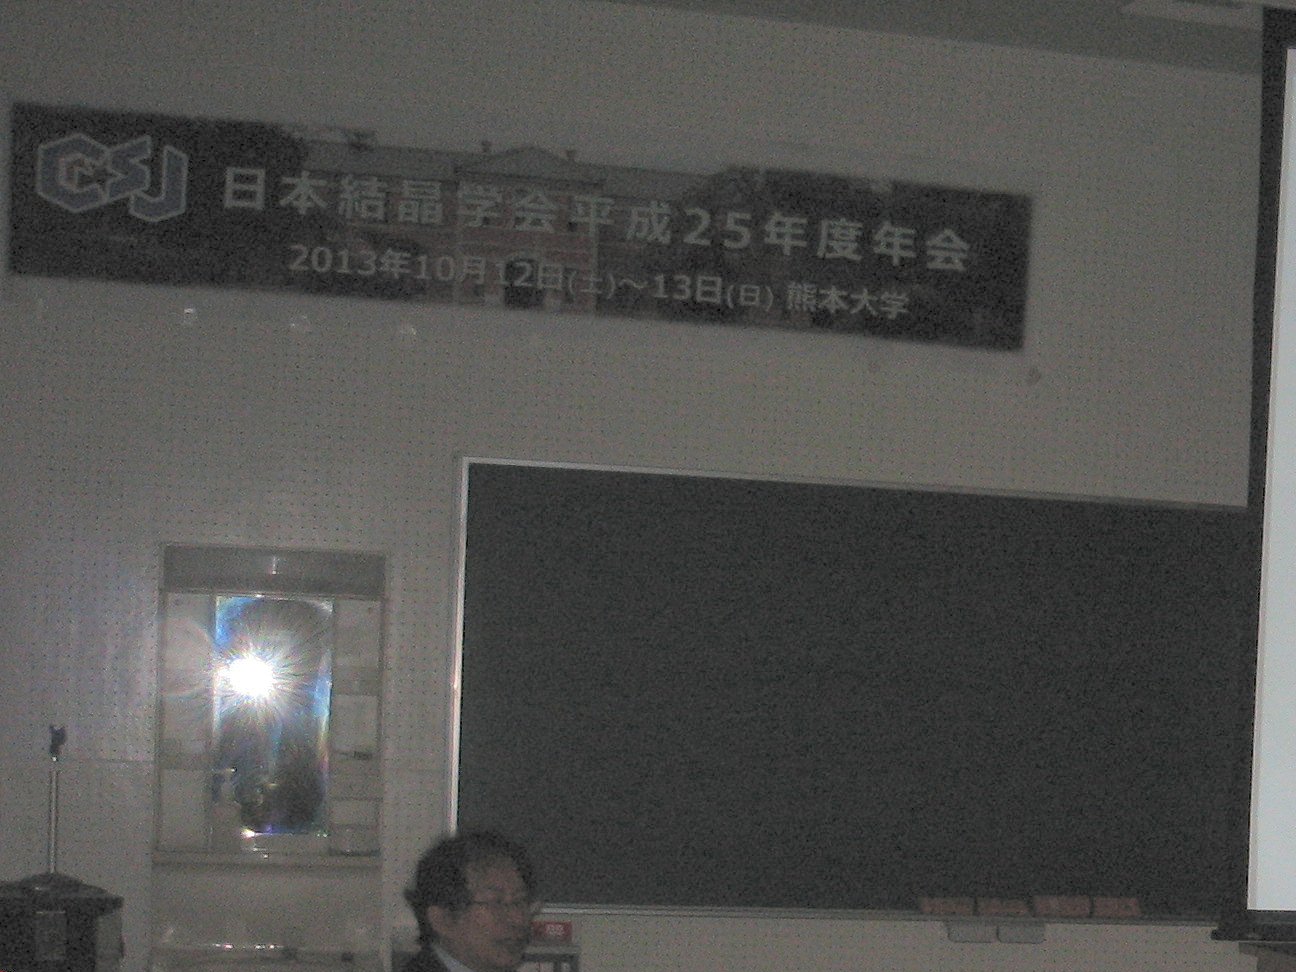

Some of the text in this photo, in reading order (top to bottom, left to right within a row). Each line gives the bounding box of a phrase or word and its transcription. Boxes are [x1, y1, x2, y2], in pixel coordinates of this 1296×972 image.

[36, 132, 189, 223] CSJ
[222, 165, 971, 272] 日本結晶学会平成25年度年会
[786, 280, 910, 320] 熊本大学
